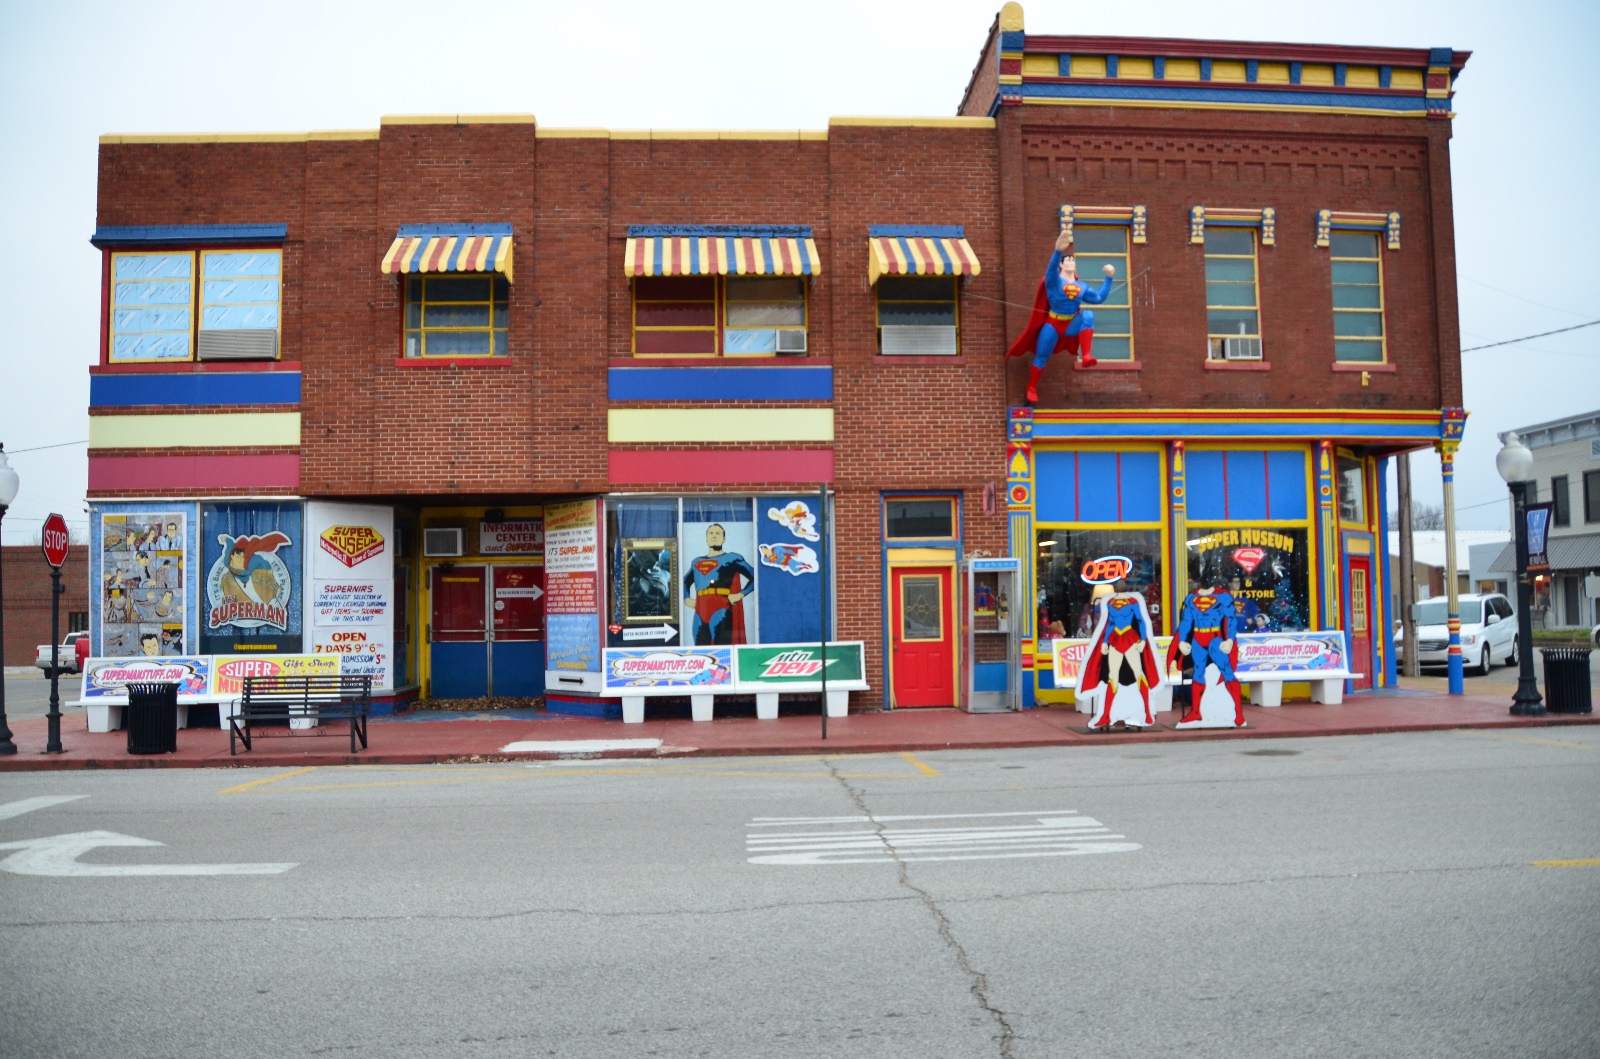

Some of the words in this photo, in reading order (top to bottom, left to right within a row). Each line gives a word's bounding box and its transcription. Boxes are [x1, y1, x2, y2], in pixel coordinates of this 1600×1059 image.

[333, 526, 374, 538] SUPER
[483, 522, 543, 533] INFORMATIO
[45, 529, 66, 551] STOP
[496, 533, 536, 542] CENTER
[1198, 529, 1240, 553] SUPER
[1240, 529, 1294, 553] MUSEUM
[329, 536, 377, 555] MUSEUM
[485, 543, 504, 552] and
[1082, 559, 1128, 580] OPEN
[1245, 578, 1253, 587] &
[324, 585, 373, 593] SUPERNIRS
[1245, 589, 1275, 598] STORE
[211, 602, 285, 625] SUPERMAN
[331, 632, 367, 642] OPEN
[315, 643, 322, 653] 7
[325, 644, 352, 653] DAYS
[1245, 644, 1320, 656] SUPERMANSTUFF.COM
[283, 660, 304, 669] Gift
[308, 659, 336, 668] Shop
[341, 655, 374, 663] ADMISSION
[226, 661, 272, 678] SUPER
[351, 666, 361, 674] and
[622, 659, 705, 672] SUPERMANSTUFF.COM
[102, 669, 183, 681] SUPERMANSTUFF.COM
